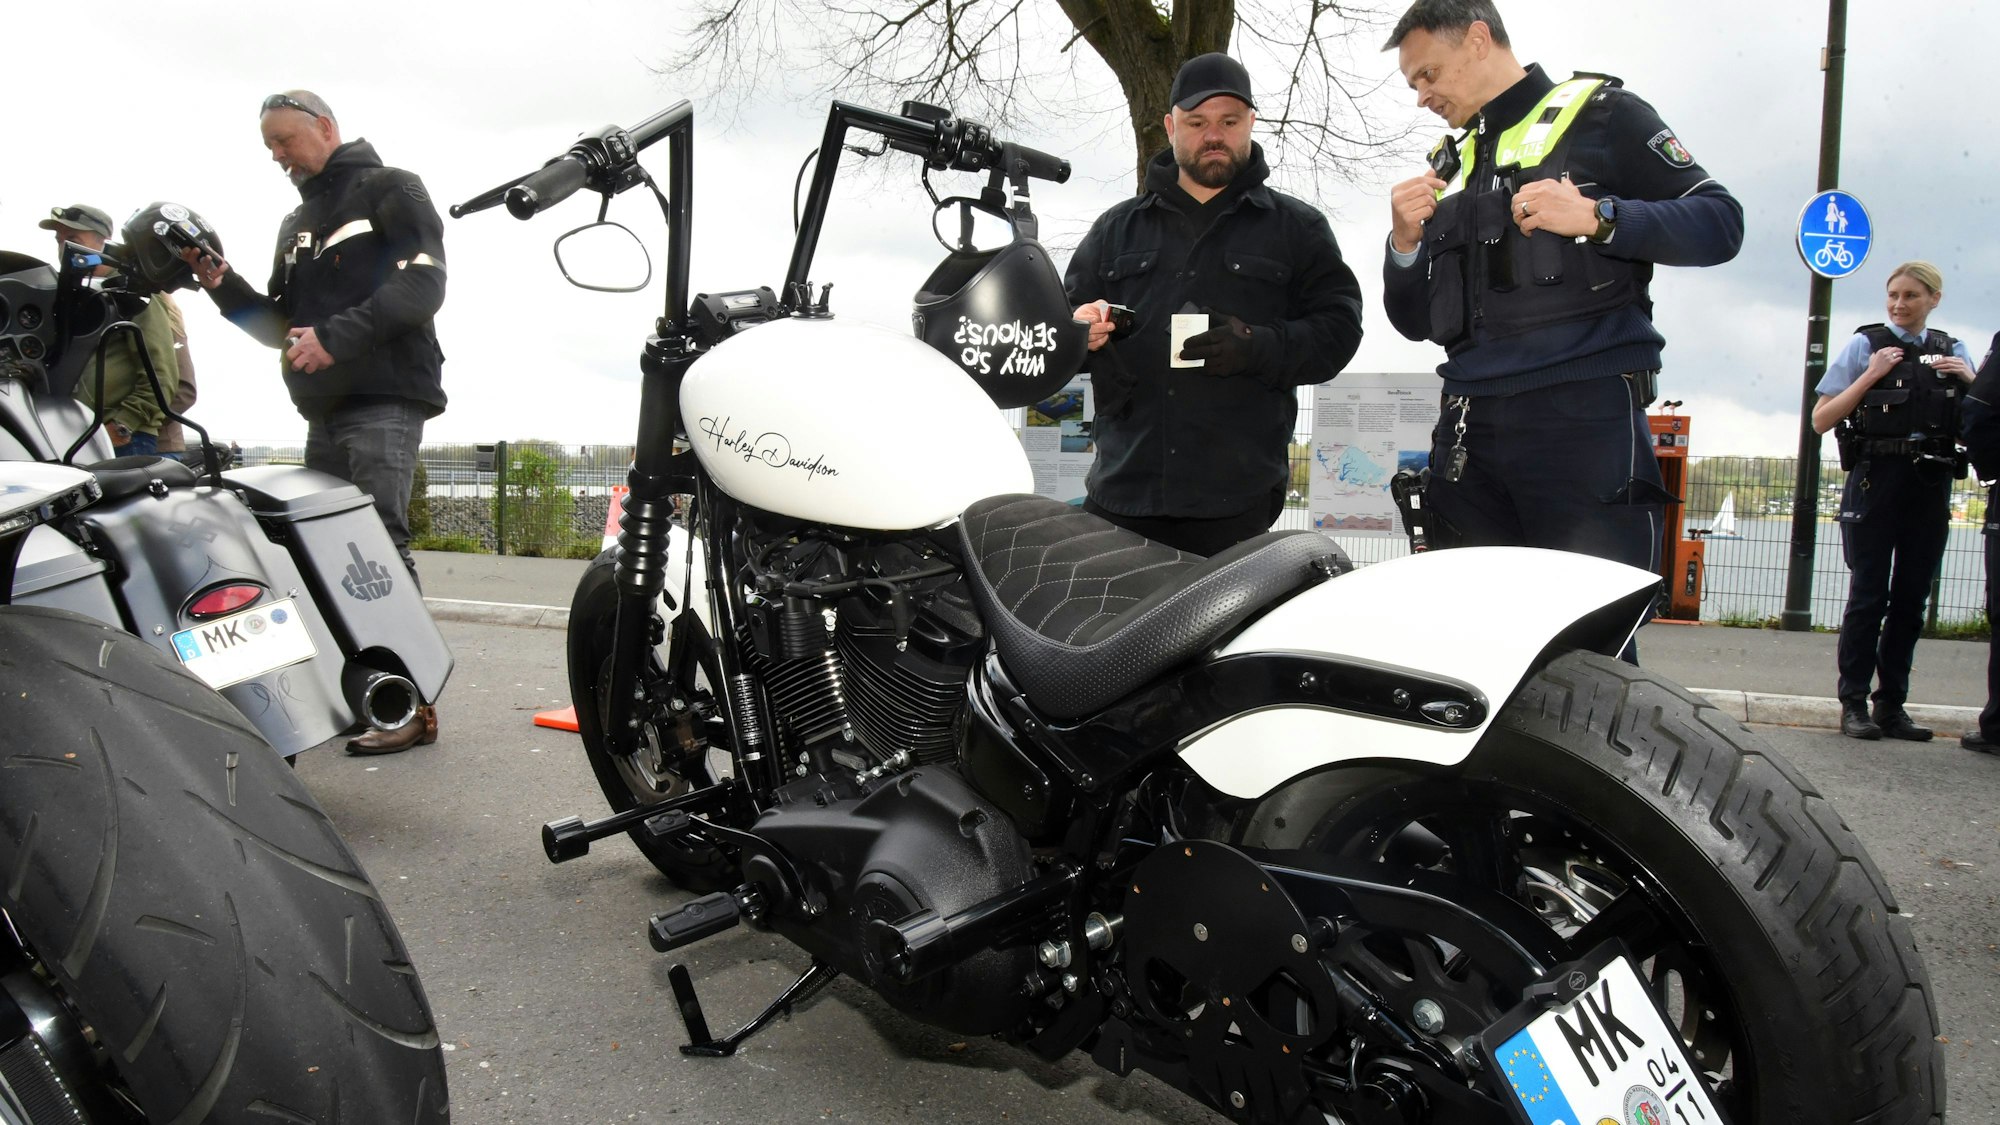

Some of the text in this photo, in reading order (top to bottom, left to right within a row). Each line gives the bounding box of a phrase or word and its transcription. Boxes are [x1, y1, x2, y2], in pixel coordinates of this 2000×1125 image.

[954, 315, 1057, 351] SERIOUS?
[961, 346, 1045, 377] WHY SO
[699, 416, 839, 481] Harley Davidson
[341, 541, 393, 597] FUCK
[354, 579, 393, 601] YOU
[186, 648, 197, 659] D
[202, 619, 248, 653] MK
[1554, 978, 1646, 1087] MK
[1646, 1047, 1680, 1088] 04
[1674, 1090, 1706, 1125] 11
